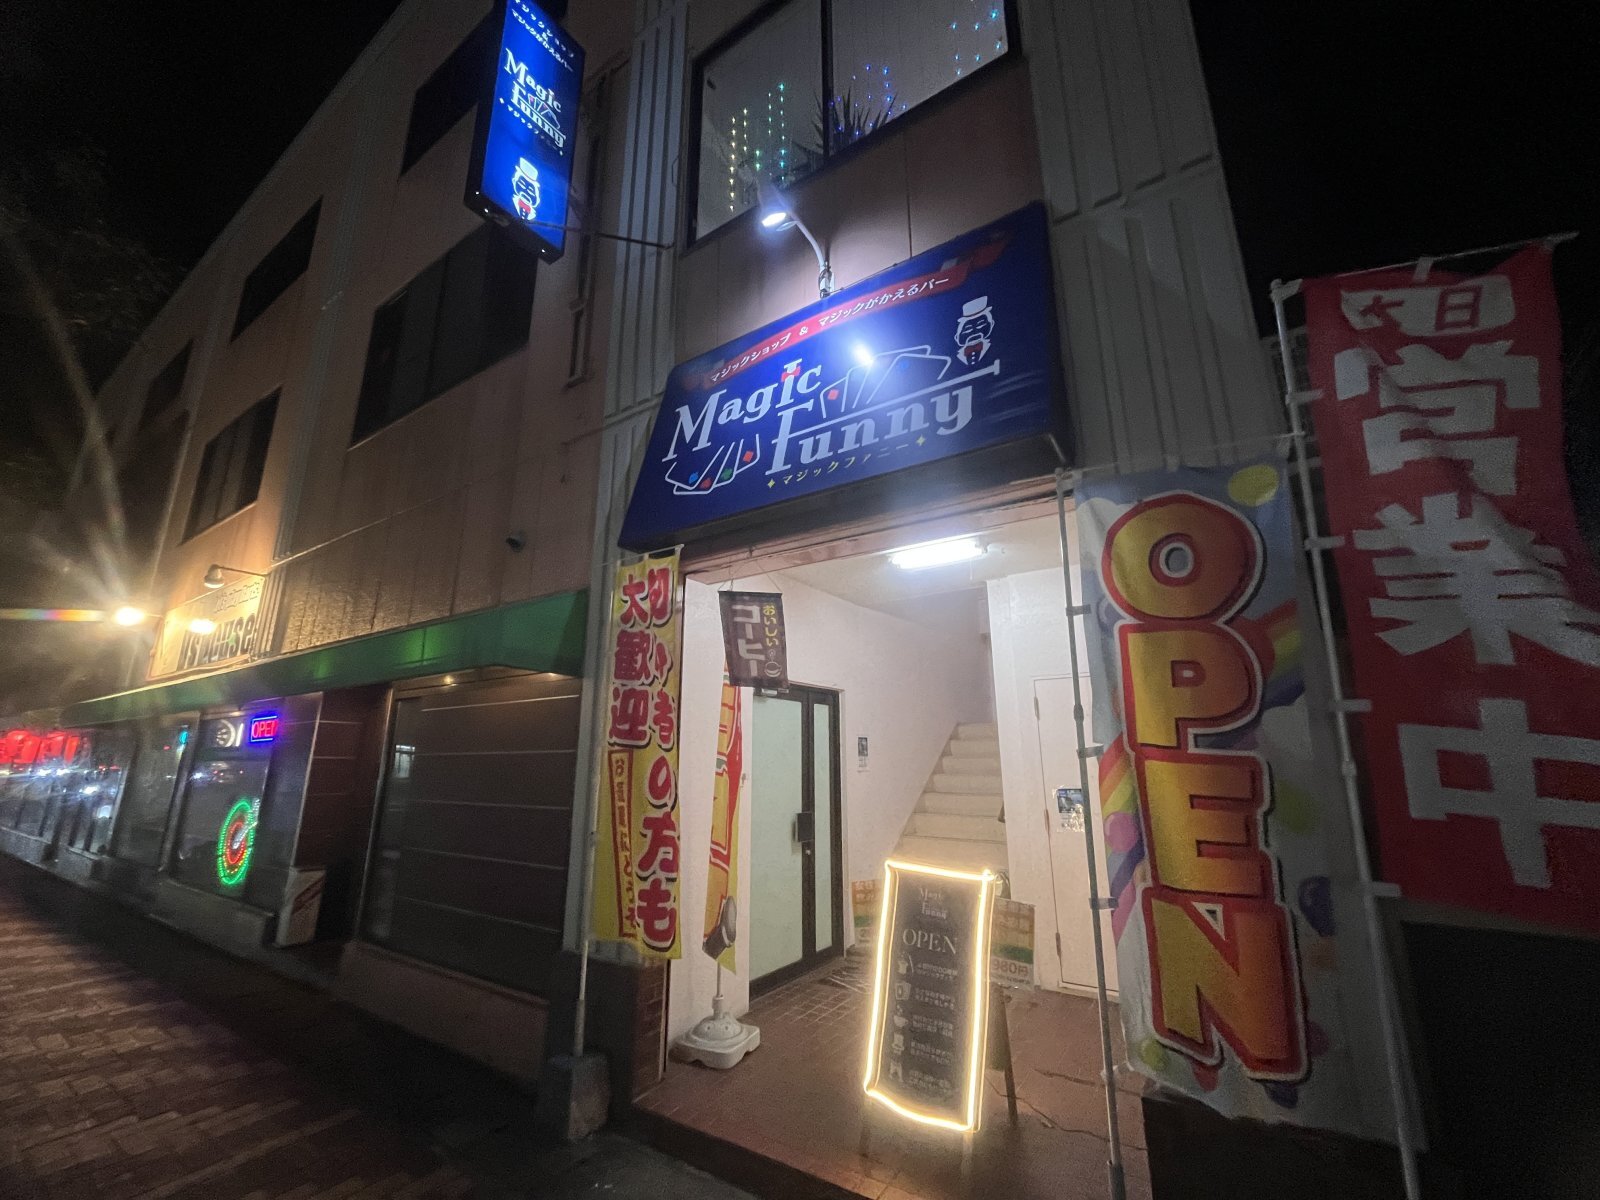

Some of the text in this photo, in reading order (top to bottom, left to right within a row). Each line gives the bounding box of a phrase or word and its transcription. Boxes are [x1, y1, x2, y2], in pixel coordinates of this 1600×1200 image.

[504, 47, 562, 113] Magic
[511, 80, 567, 149] Funny
[709, 277, 949, 382] マジックショップ & マジックがかえるバー
[662, 359, 823, 463] Magic
[765, 367, 993, 477] Funny
[782, 443, 910, 485] マジックファニー
[609, 573, 652, 742] 大歓迎
[731, 604, 767, 678] コーヒー
[762, 603, 779, 647] おいしい
[1334, 340, 1600, 889] 営業中
[1101, 491, 1310, 1082] OPEN
[902, 928, 958, 955] OPEN
